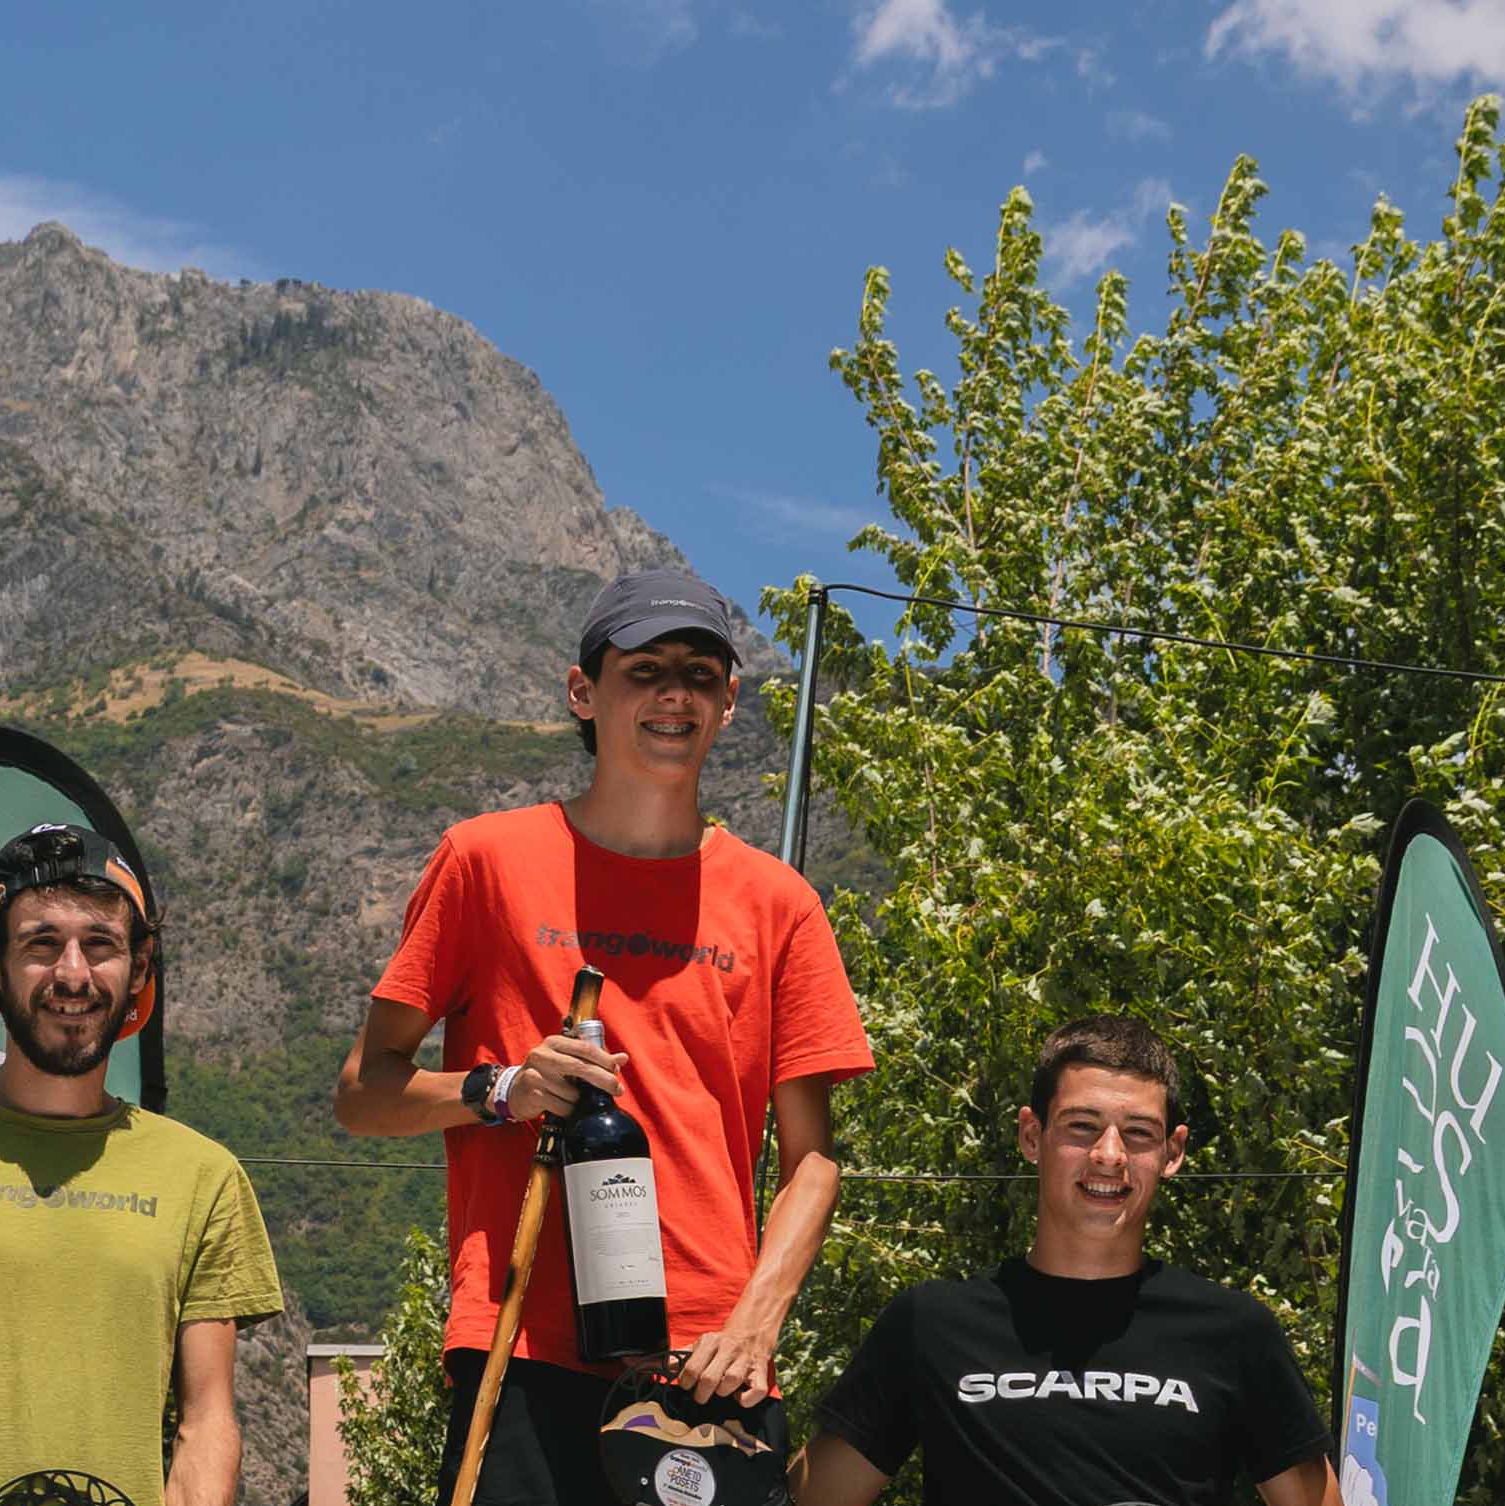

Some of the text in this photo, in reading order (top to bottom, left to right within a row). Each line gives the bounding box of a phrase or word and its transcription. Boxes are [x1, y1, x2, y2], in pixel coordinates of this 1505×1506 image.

[590, 1185, 647, 1202] SOMMOS
[957, 1369, 1199, 1414] SCARPA
[1356, 1412, 1378, 1441] Pe
